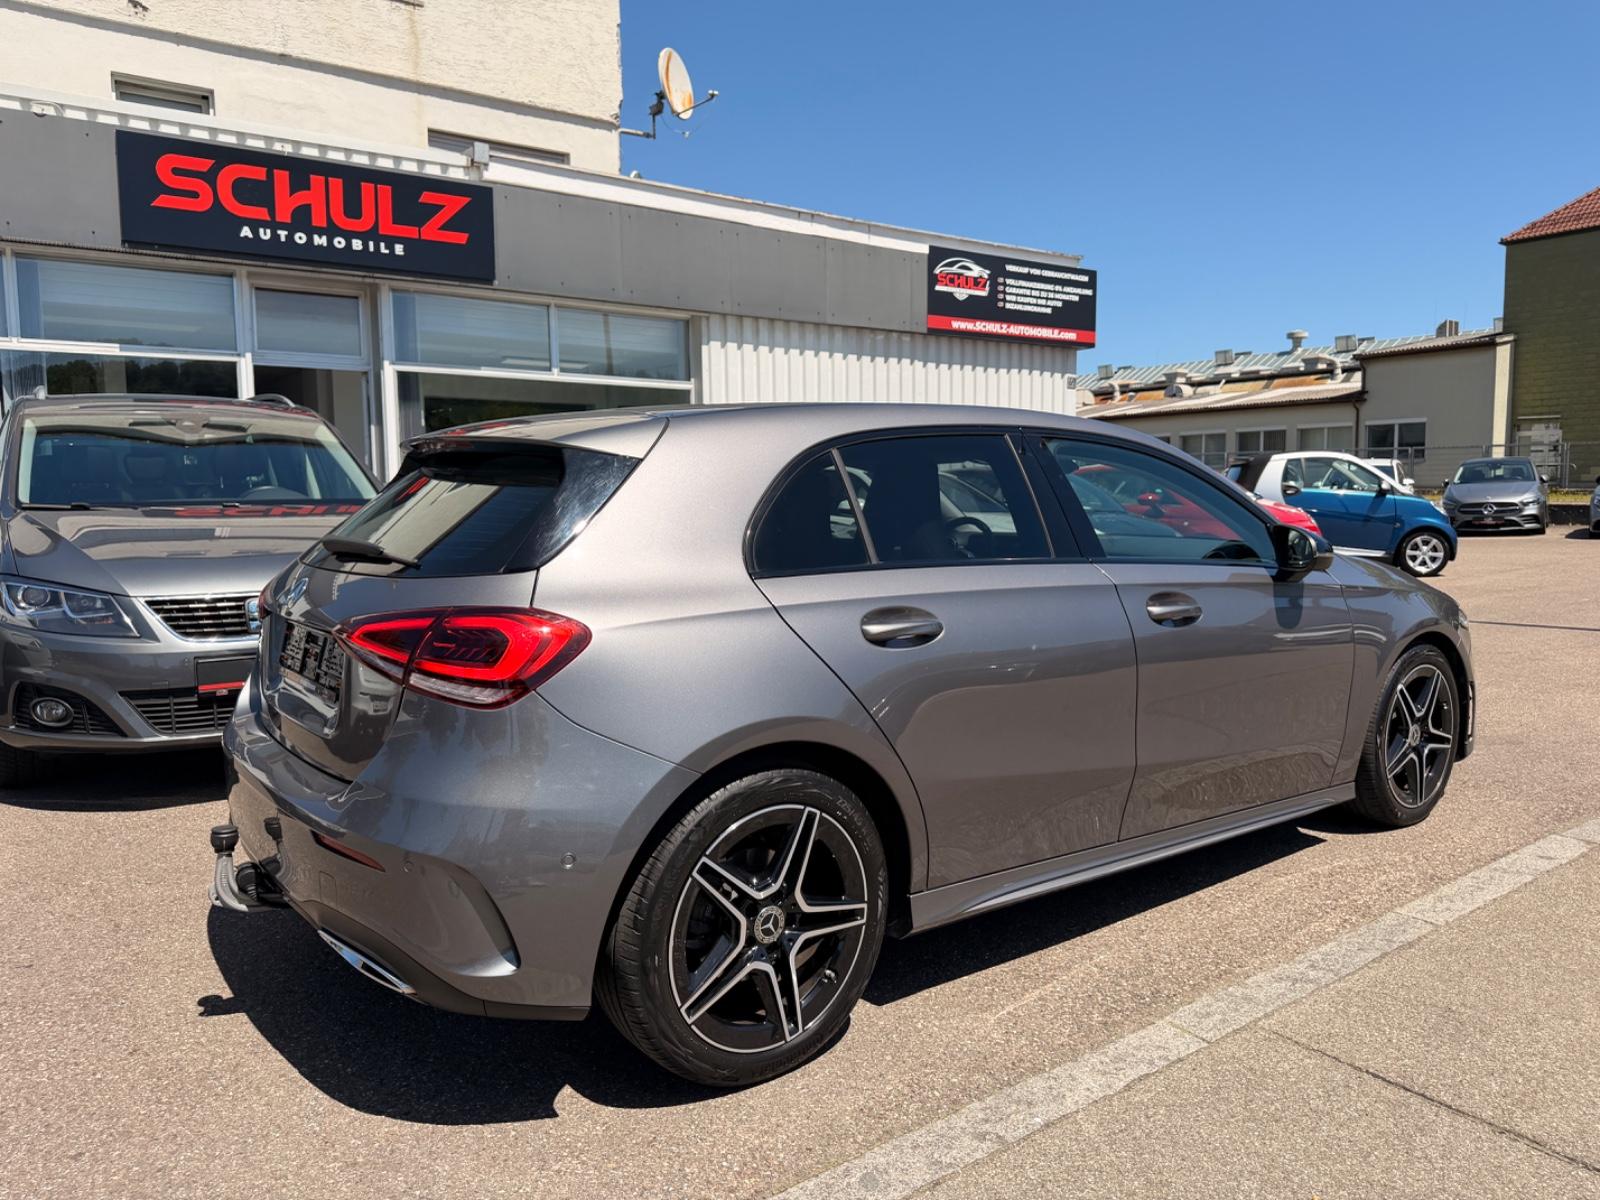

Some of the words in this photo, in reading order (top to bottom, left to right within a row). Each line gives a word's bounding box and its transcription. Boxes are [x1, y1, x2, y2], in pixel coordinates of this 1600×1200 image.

[150, 153, 472, 244] SCHULZ
[239, 225, 405, 256] AUTOMOBILE
[936, 272, 986, 291] SCHULZ
[1029, 268, 1042, 276] VON
[950, 320, 1077, 341] www.SCHULZ-AUTOMOBILE.com
